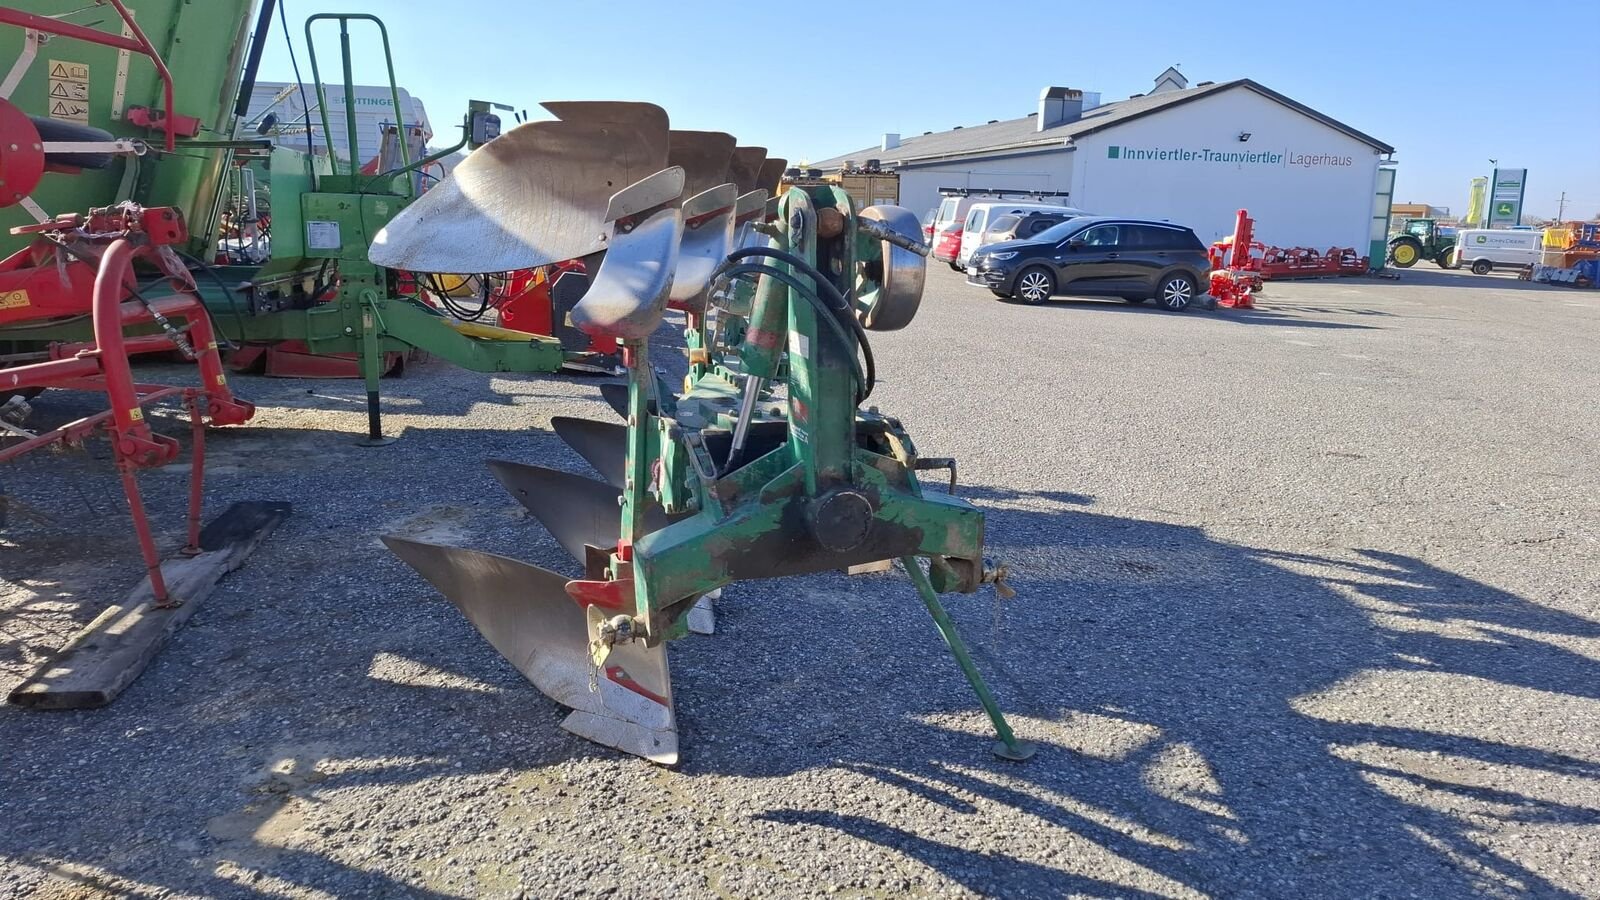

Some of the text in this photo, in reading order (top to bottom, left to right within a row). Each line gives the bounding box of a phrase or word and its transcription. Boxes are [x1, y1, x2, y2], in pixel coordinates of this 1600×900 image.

[341, 97, 400, 106] PTTINGE
[1123, 146, 1352, 168] Innviertler-Traunviertler Lagerhaus
